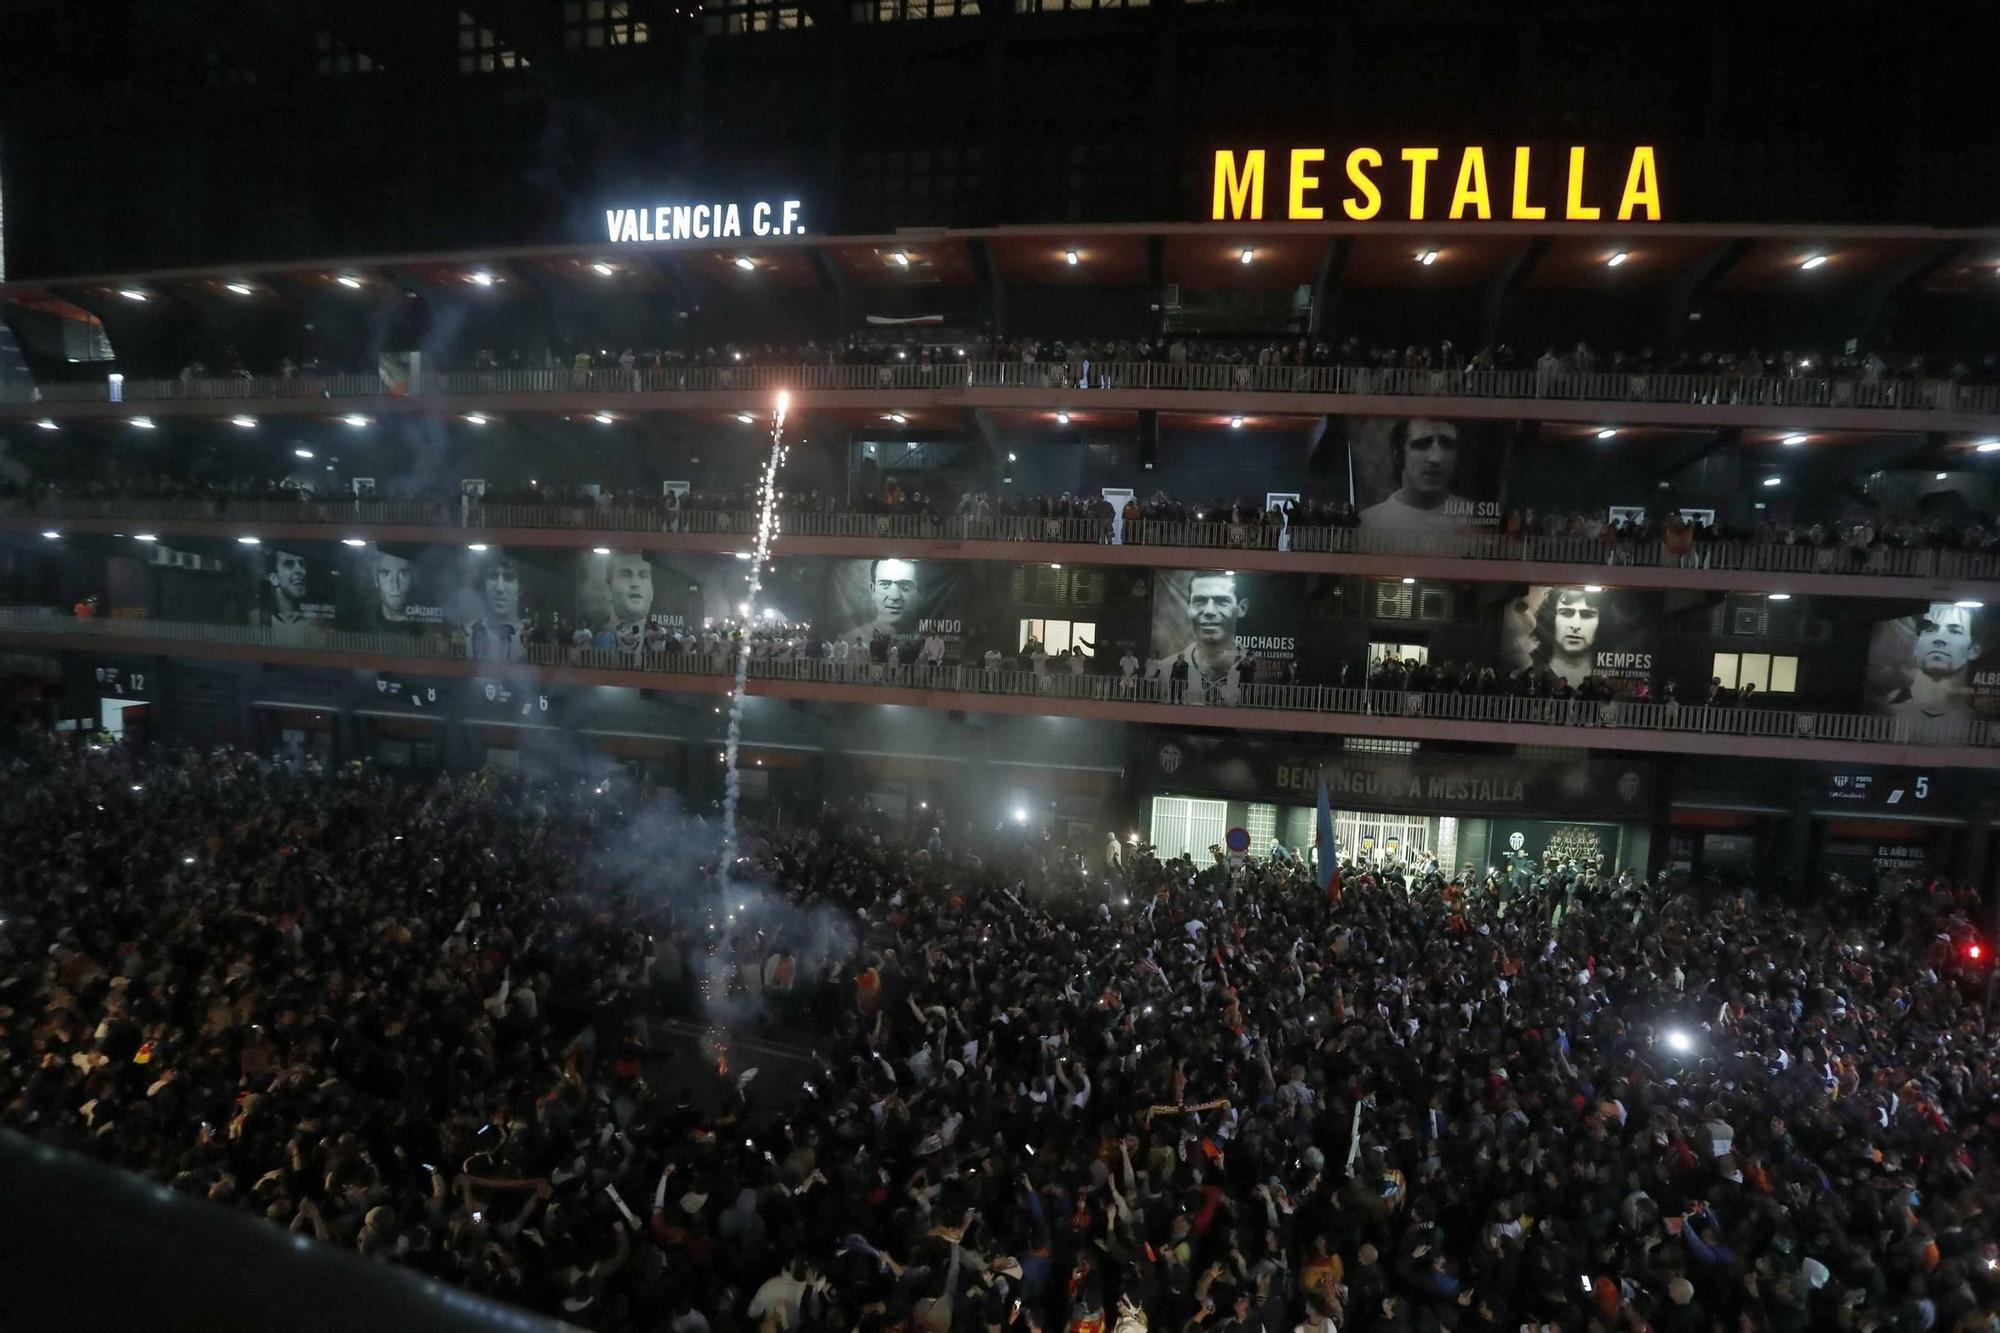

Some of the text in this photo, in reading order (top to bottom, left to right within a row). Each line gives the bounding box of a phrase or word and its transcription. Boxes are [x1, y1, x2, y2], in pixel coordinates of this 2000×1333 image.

[1212, 146, 1661, 220] MESTALLA
[606, 200, 805, 242] VALENCIA C.F.
[1443, 501, 1501, 517] JUAN SOL
[918, 618, 961, 633] MUNDO
[1234, 635, 1296, 650] PUCHADES
[1597, 651, 1652, 669] KEMPES
[130, 673, 145, 690] 12
[1408, 776, 1421, 798] A
[1428, 776, 1524, 801] MESTALLA
[1915, 776, 1929, 799] 5
[1878, 846, 1888, 856] EL
[1890, 846, 1907, 857] AÑO
